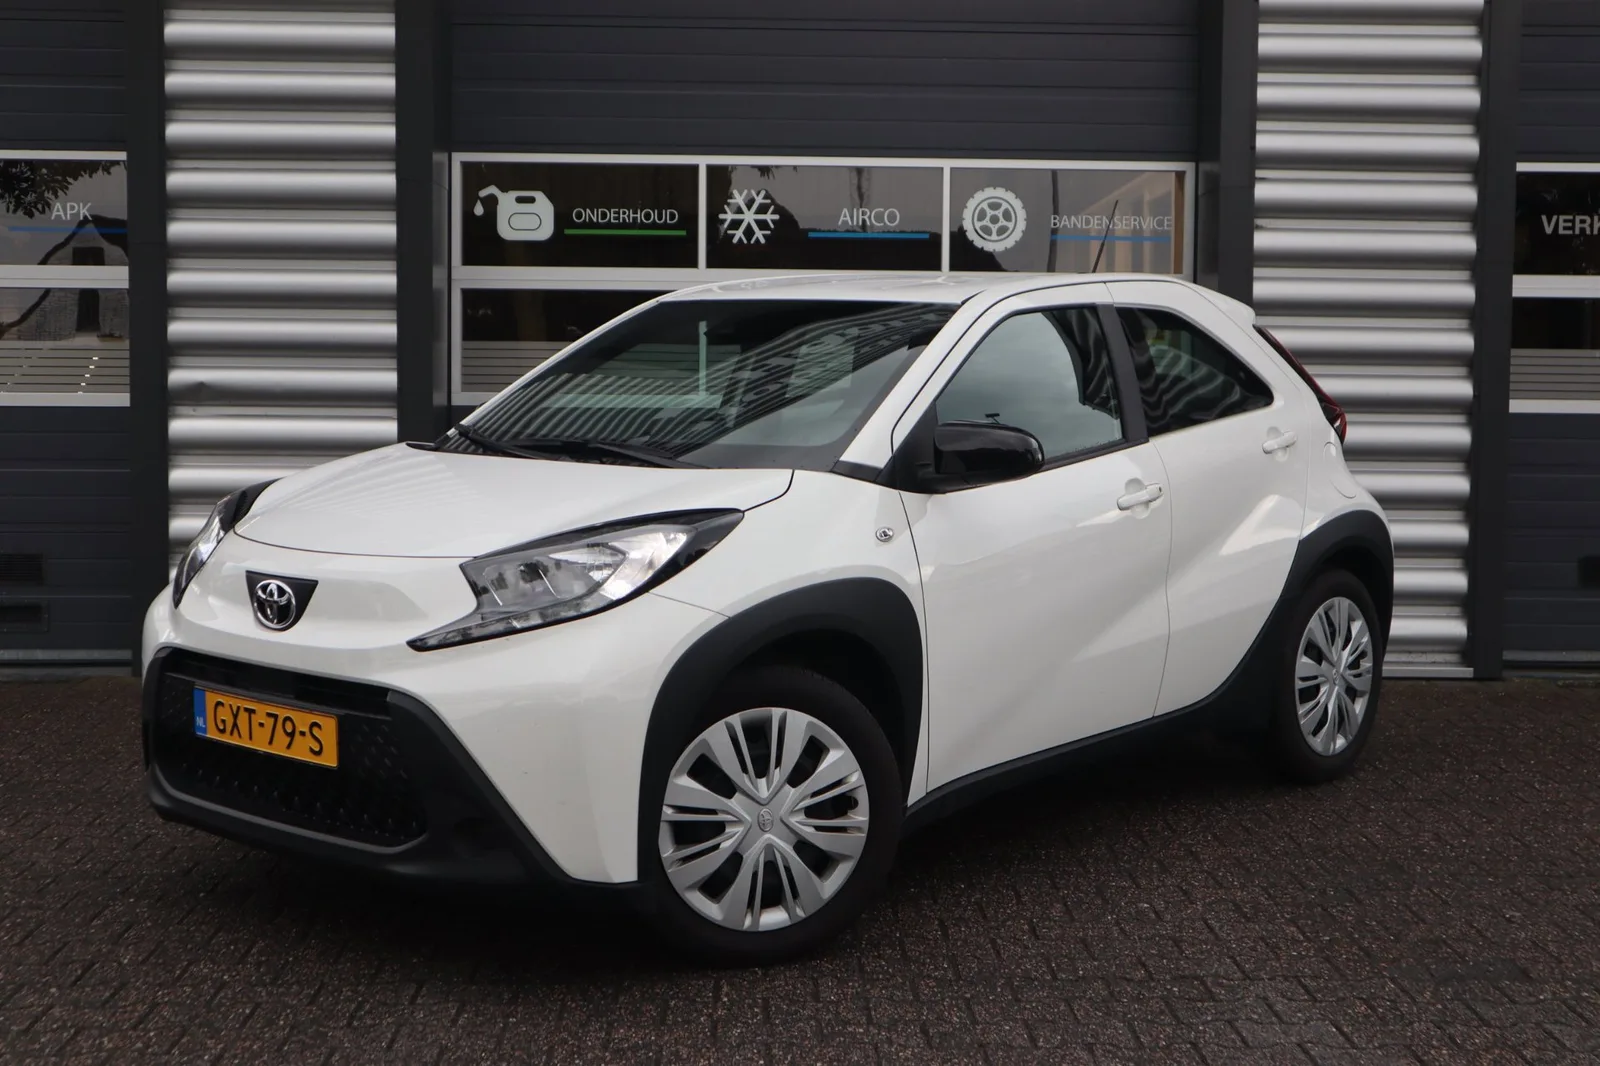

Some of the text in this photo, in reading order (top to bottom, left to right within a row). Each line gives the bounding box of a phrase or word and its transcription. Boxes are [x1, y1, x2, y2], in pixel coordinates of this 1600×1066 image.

[51, 202, 92, 220] APK
[572, 207, 679, 223] ONDERHOUD
[838, 207, 900, 226] AIRCO
[1050, 214, 1172, 230] BANDENSERVICE
[196, 716, 206, 728] NL
[213, 700, 324, 757] GXT-79-S
